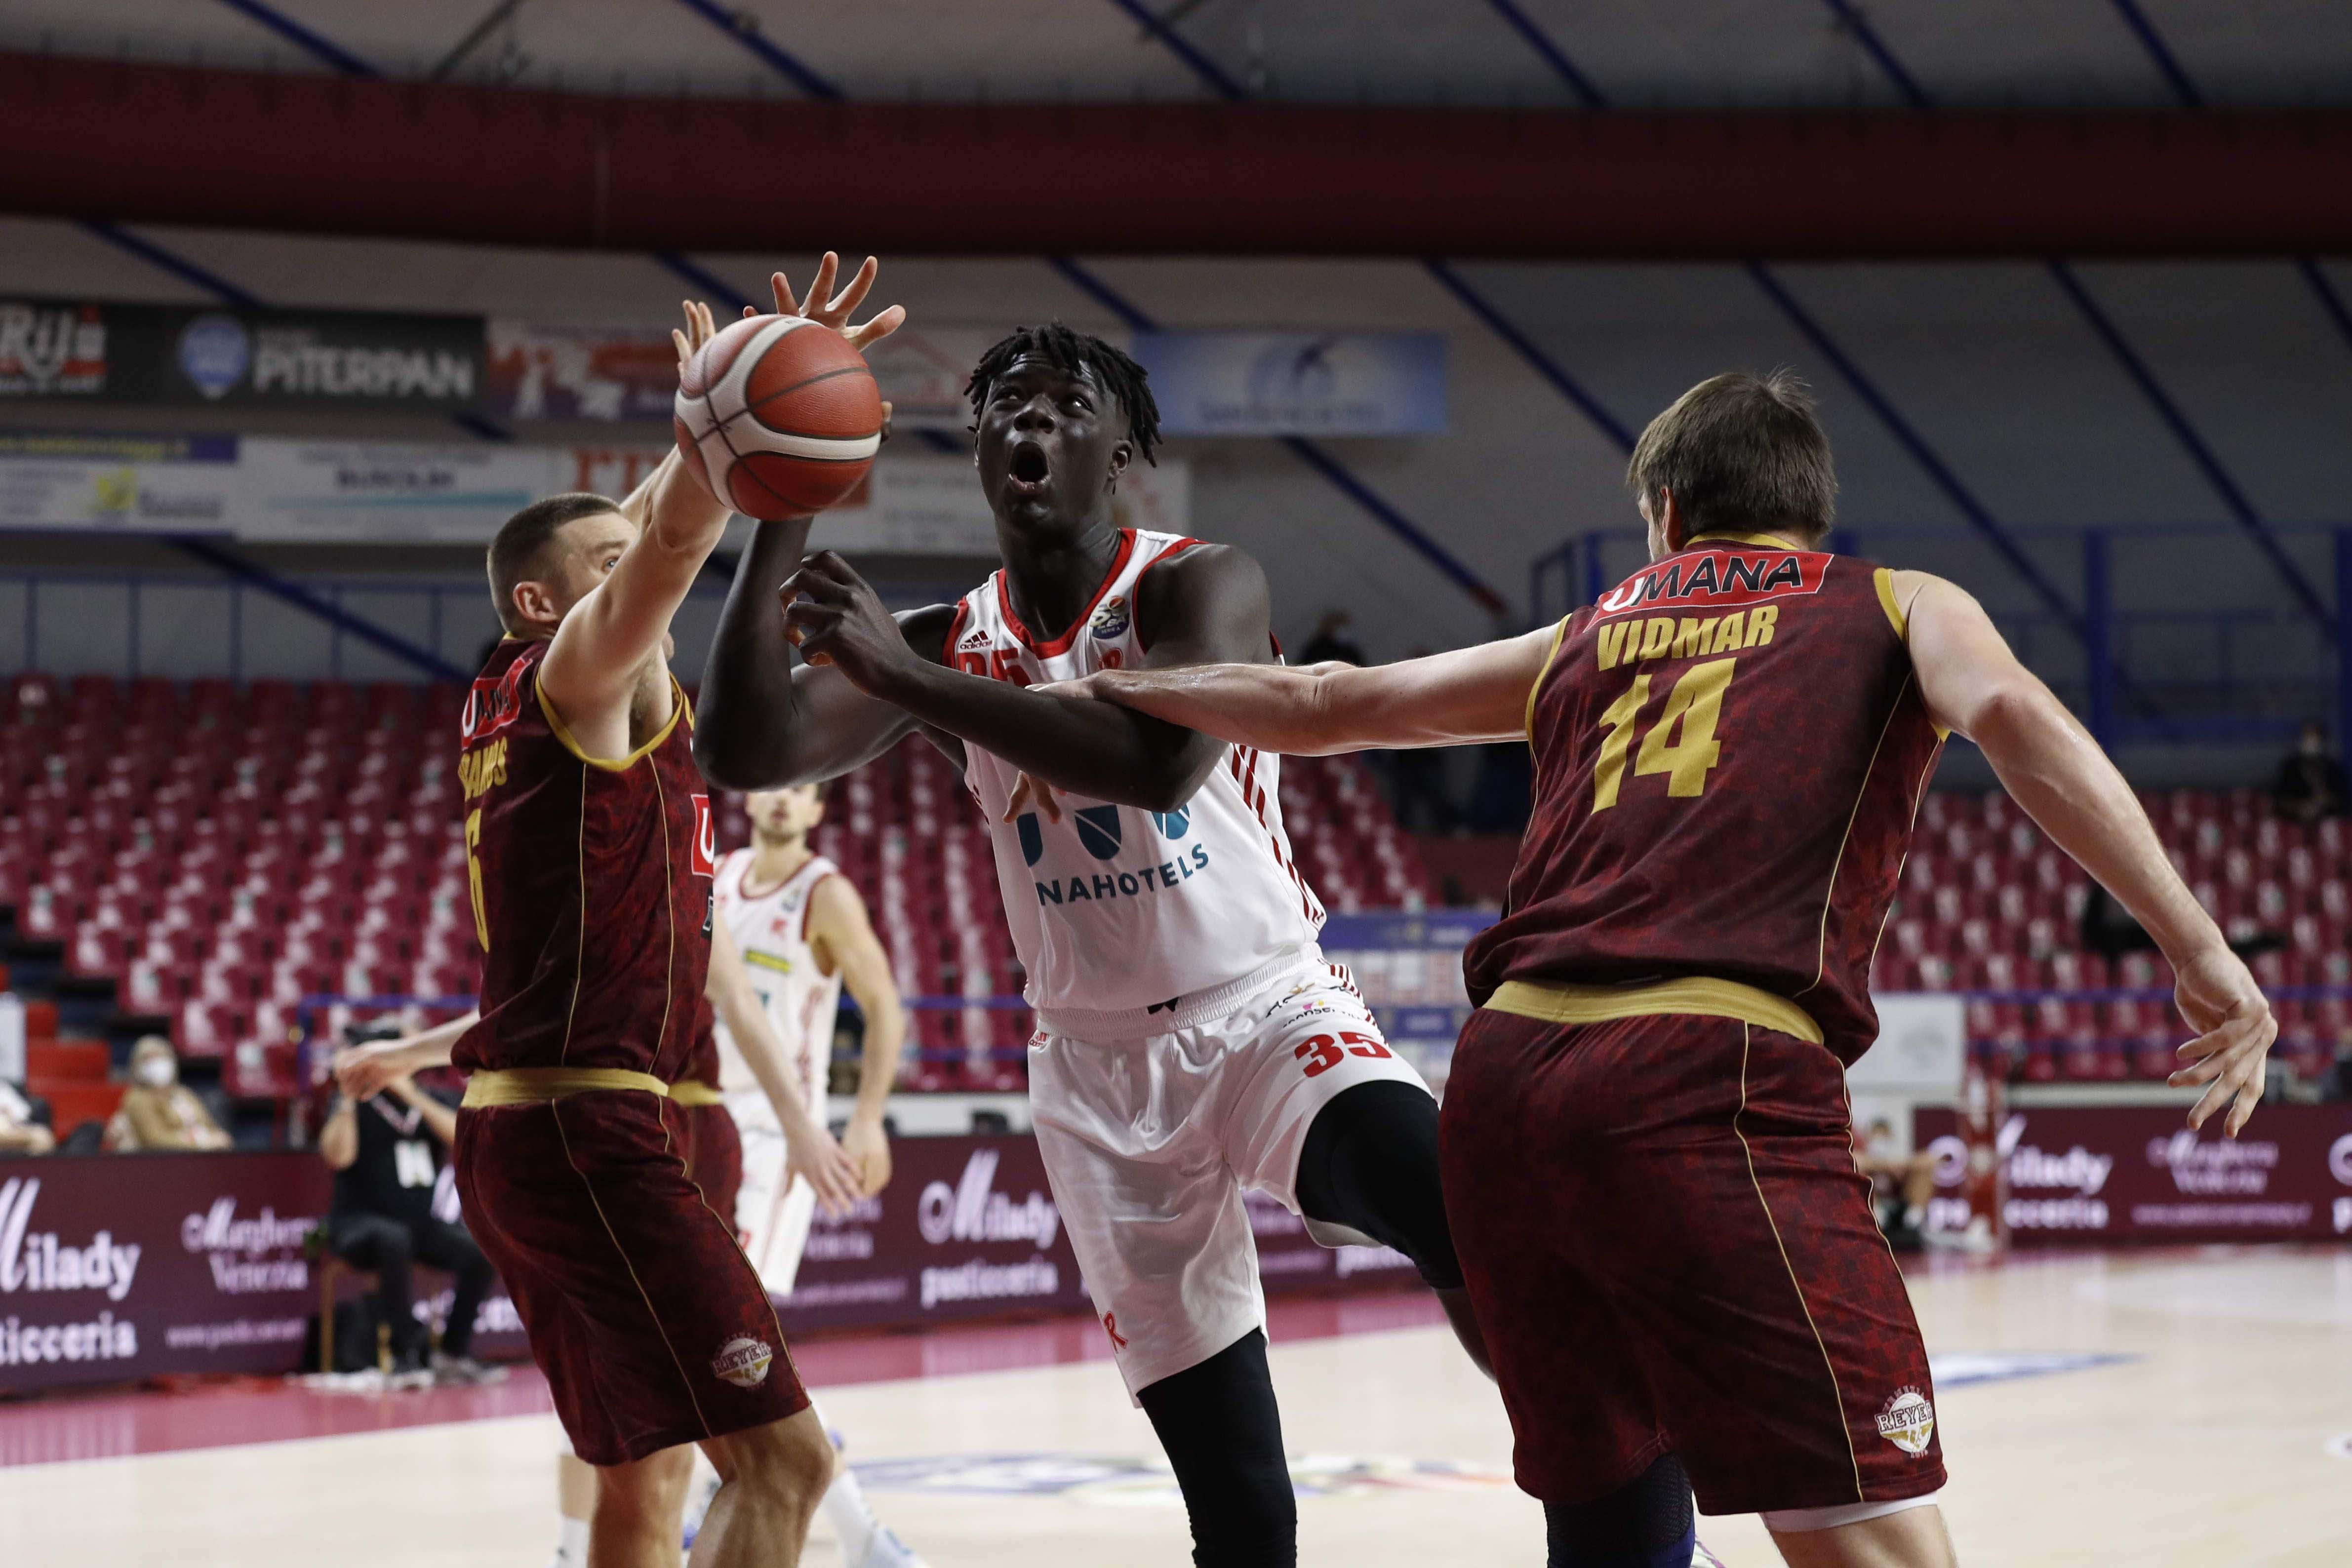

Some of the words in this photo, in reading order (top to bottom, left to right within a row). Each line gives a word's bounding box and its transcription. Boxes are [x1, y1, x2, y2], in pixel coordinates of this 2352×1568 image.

[252, 343, 475, 399] PITERPAN
[1601, 555, 1804, 612] UMANA
[959, 639, 993, 650] adidas
[1597, 604, 1779, 672] VIDMAR
[1591, 657, 1737, 815] 14
[1035, 842, 1210, 906] NAHOTELS
[1294, 1031, 1393, 1078] 35
[712, 1341, 771, 1375] REYER
[1874, 1400, 1933, 1432] REYER
